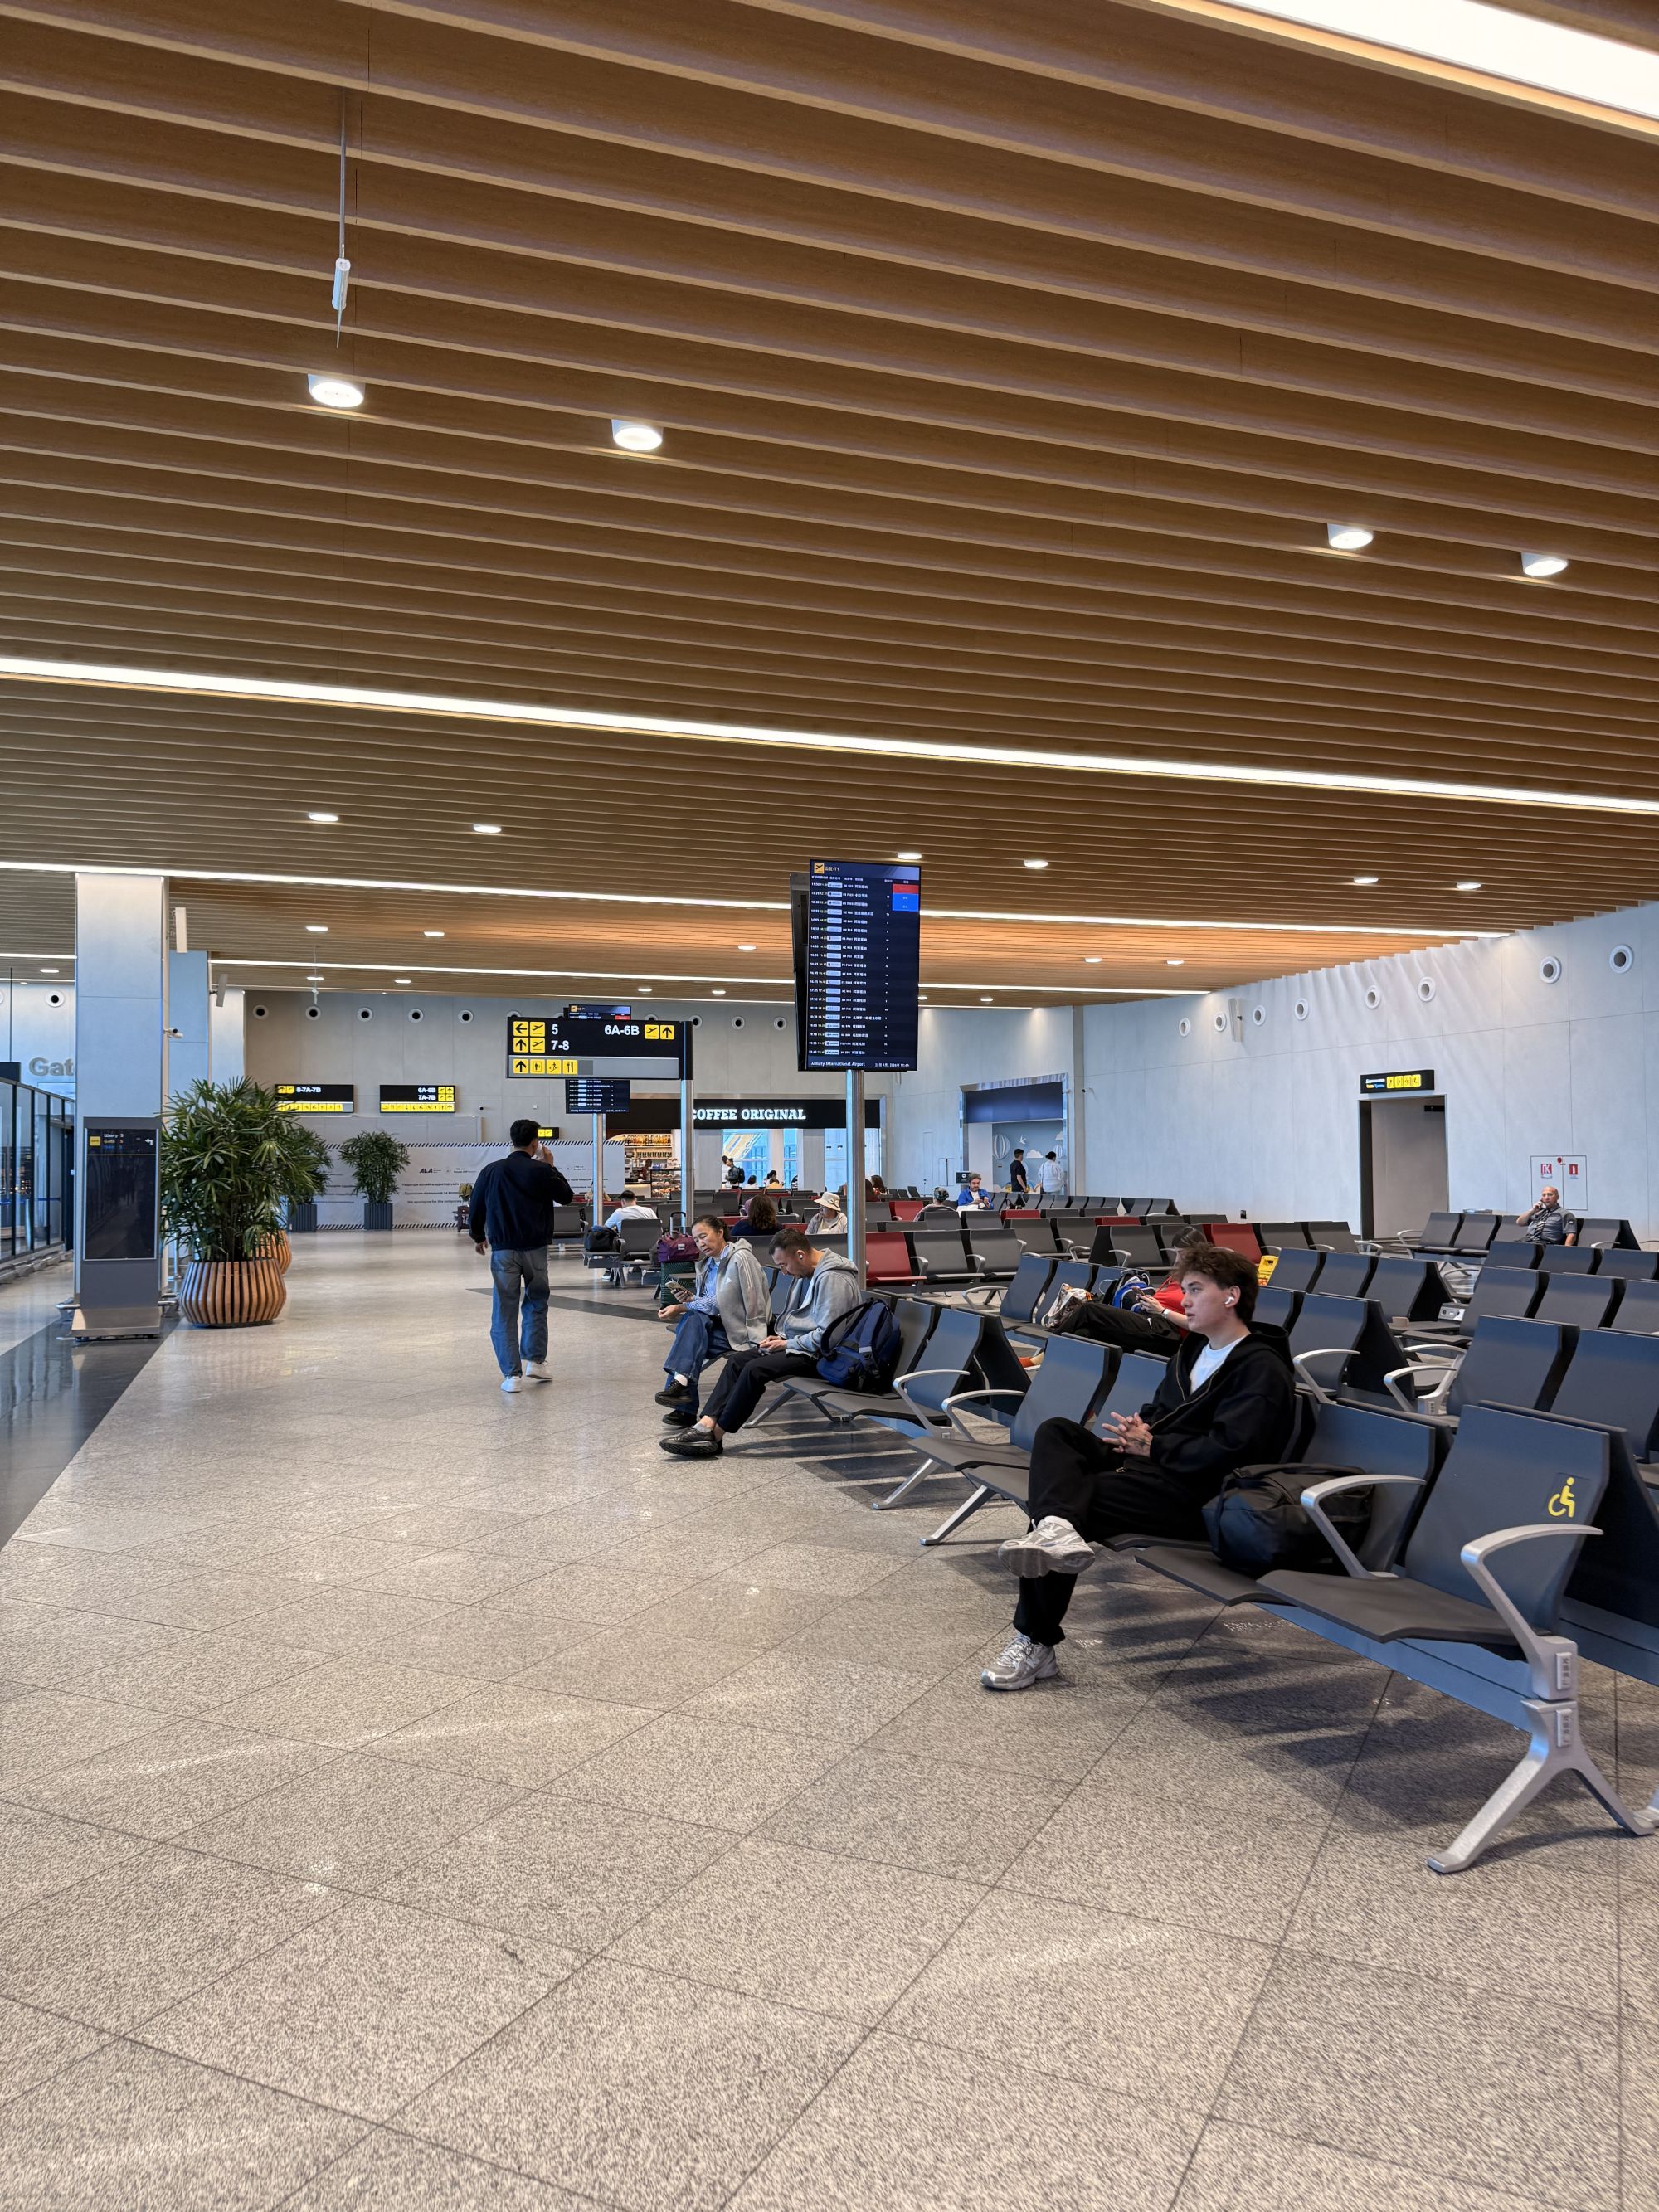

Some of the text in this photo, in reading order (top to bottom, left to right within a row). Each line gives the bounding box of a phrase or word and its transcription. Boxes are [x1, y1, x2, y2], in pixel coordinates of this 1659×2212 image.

[552, 1024, 558, 1035] 5
[604, 1024, 640, 1036] 6A-6B
[551, 1040, 569, 1050] 7-8
[29, 1057, 75, 1077] Gat
[741, 1108, 807, 1120] ORIGINAL
